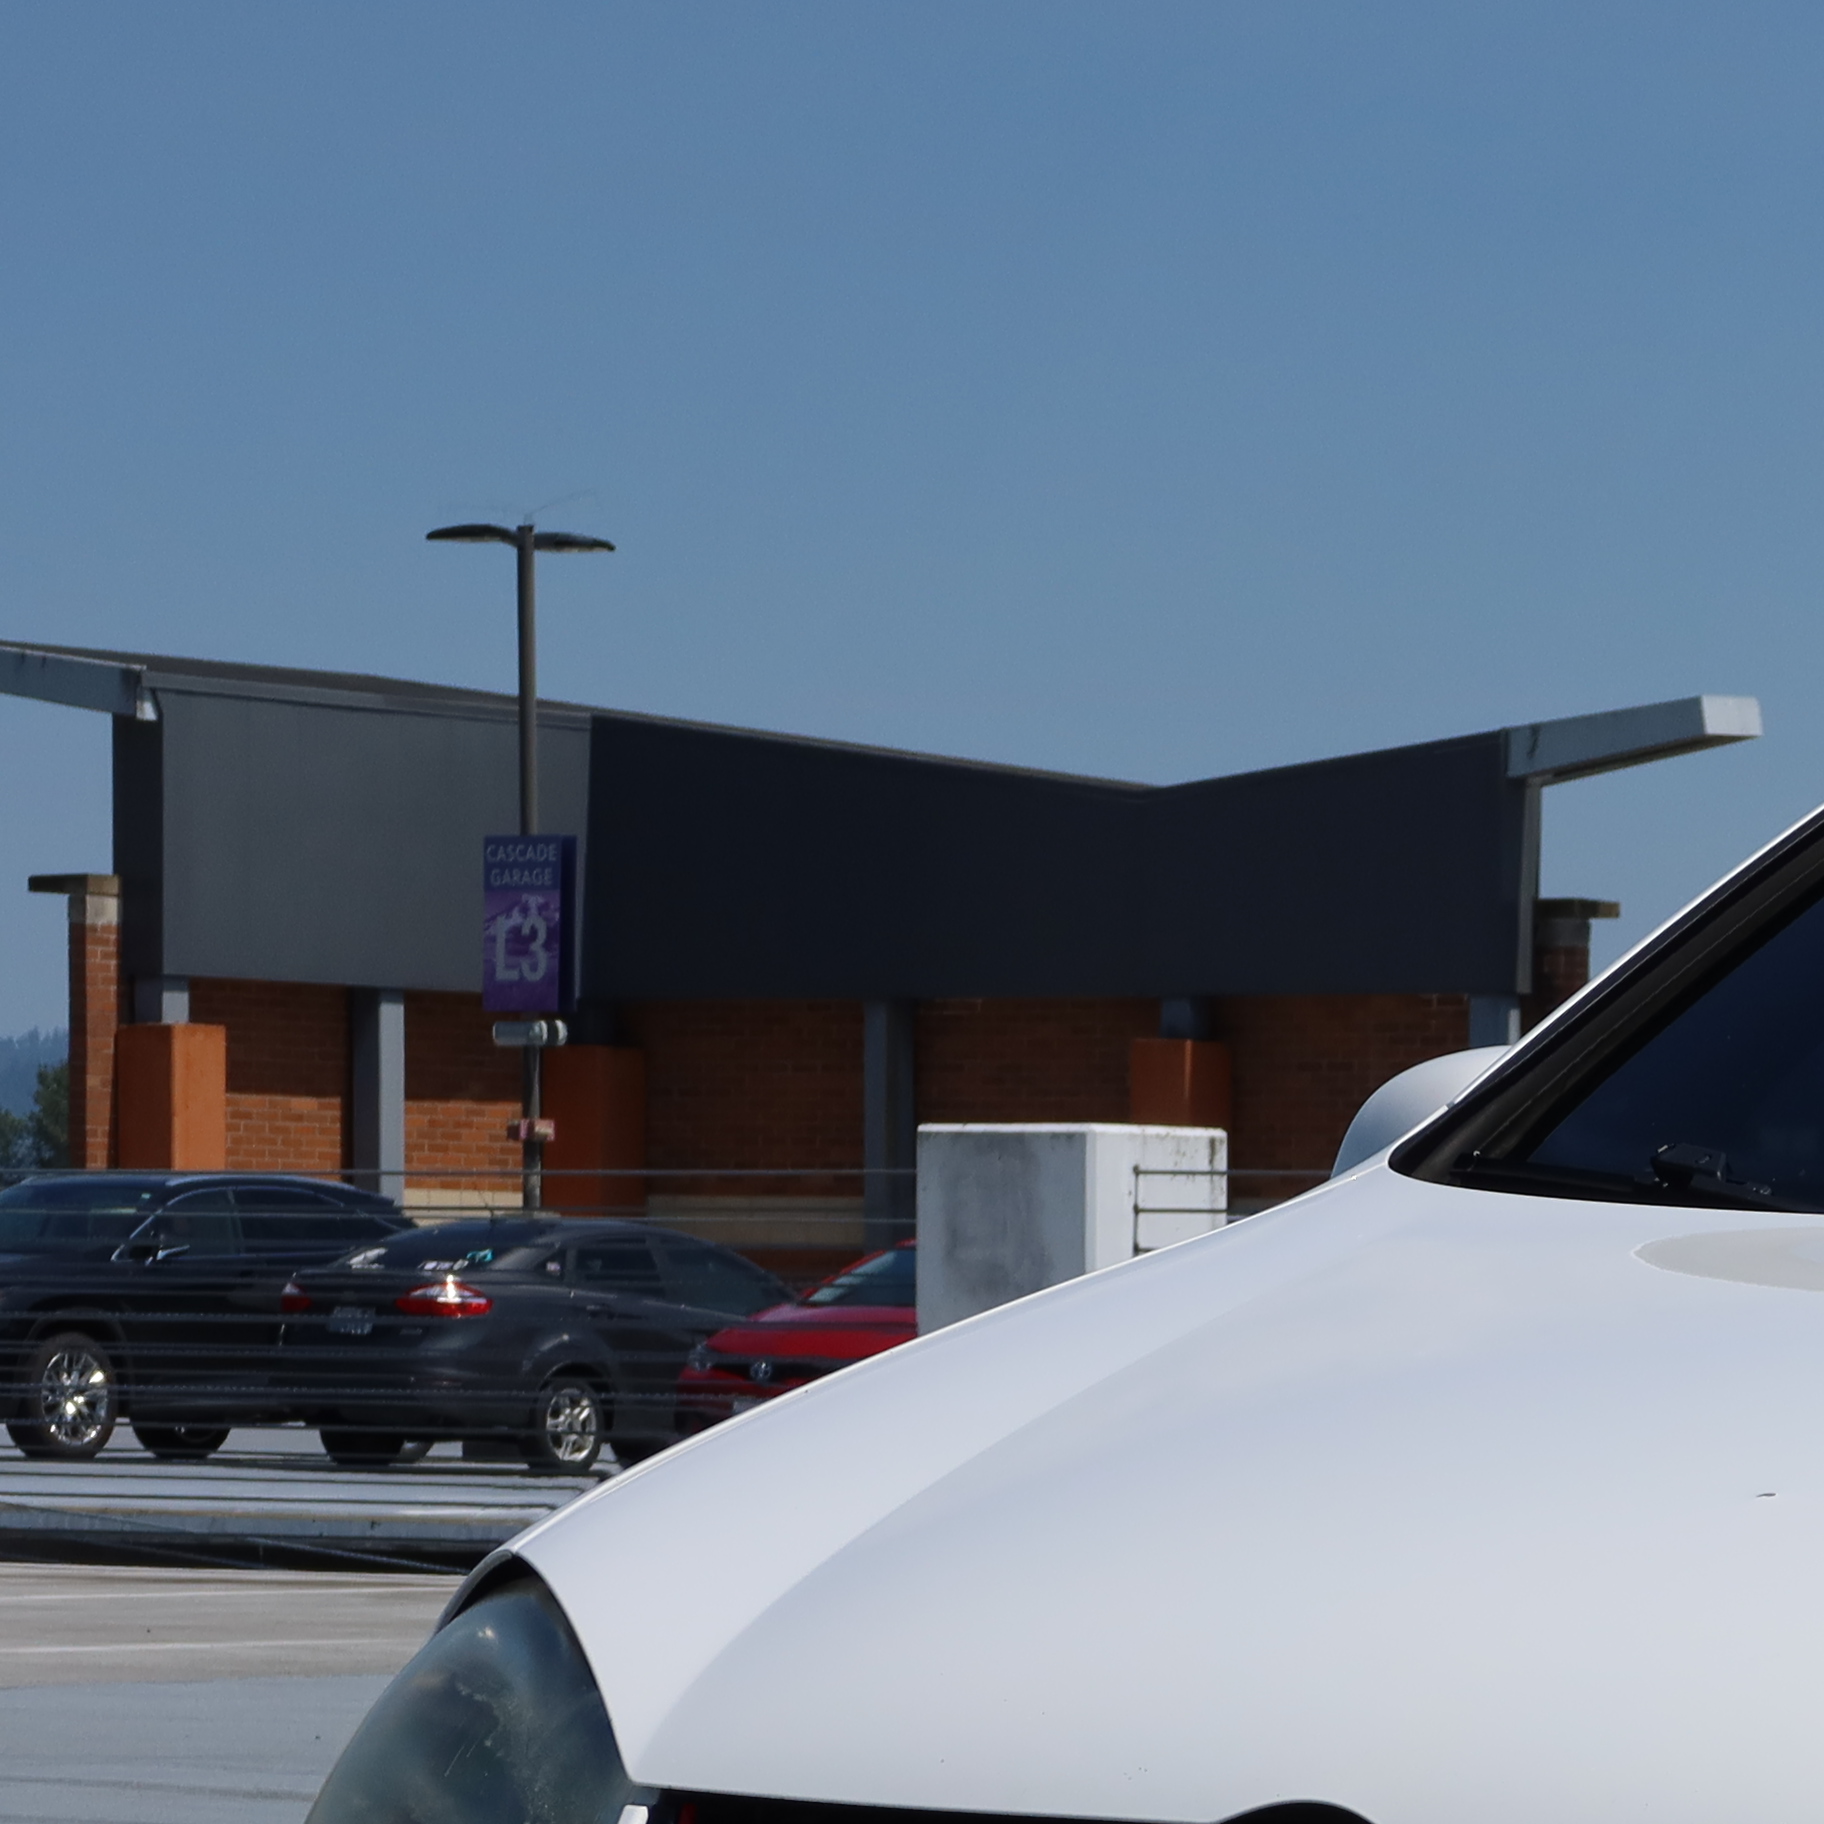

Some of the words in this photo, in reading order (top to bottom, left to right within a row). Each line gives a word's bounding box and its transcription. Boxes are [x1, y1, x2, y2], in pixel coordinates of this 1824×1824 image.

[486, 843, 557, 863] CASCADE
[489, 867, 553, 886] GARAGE
[495, 915, 548, 982] L3
